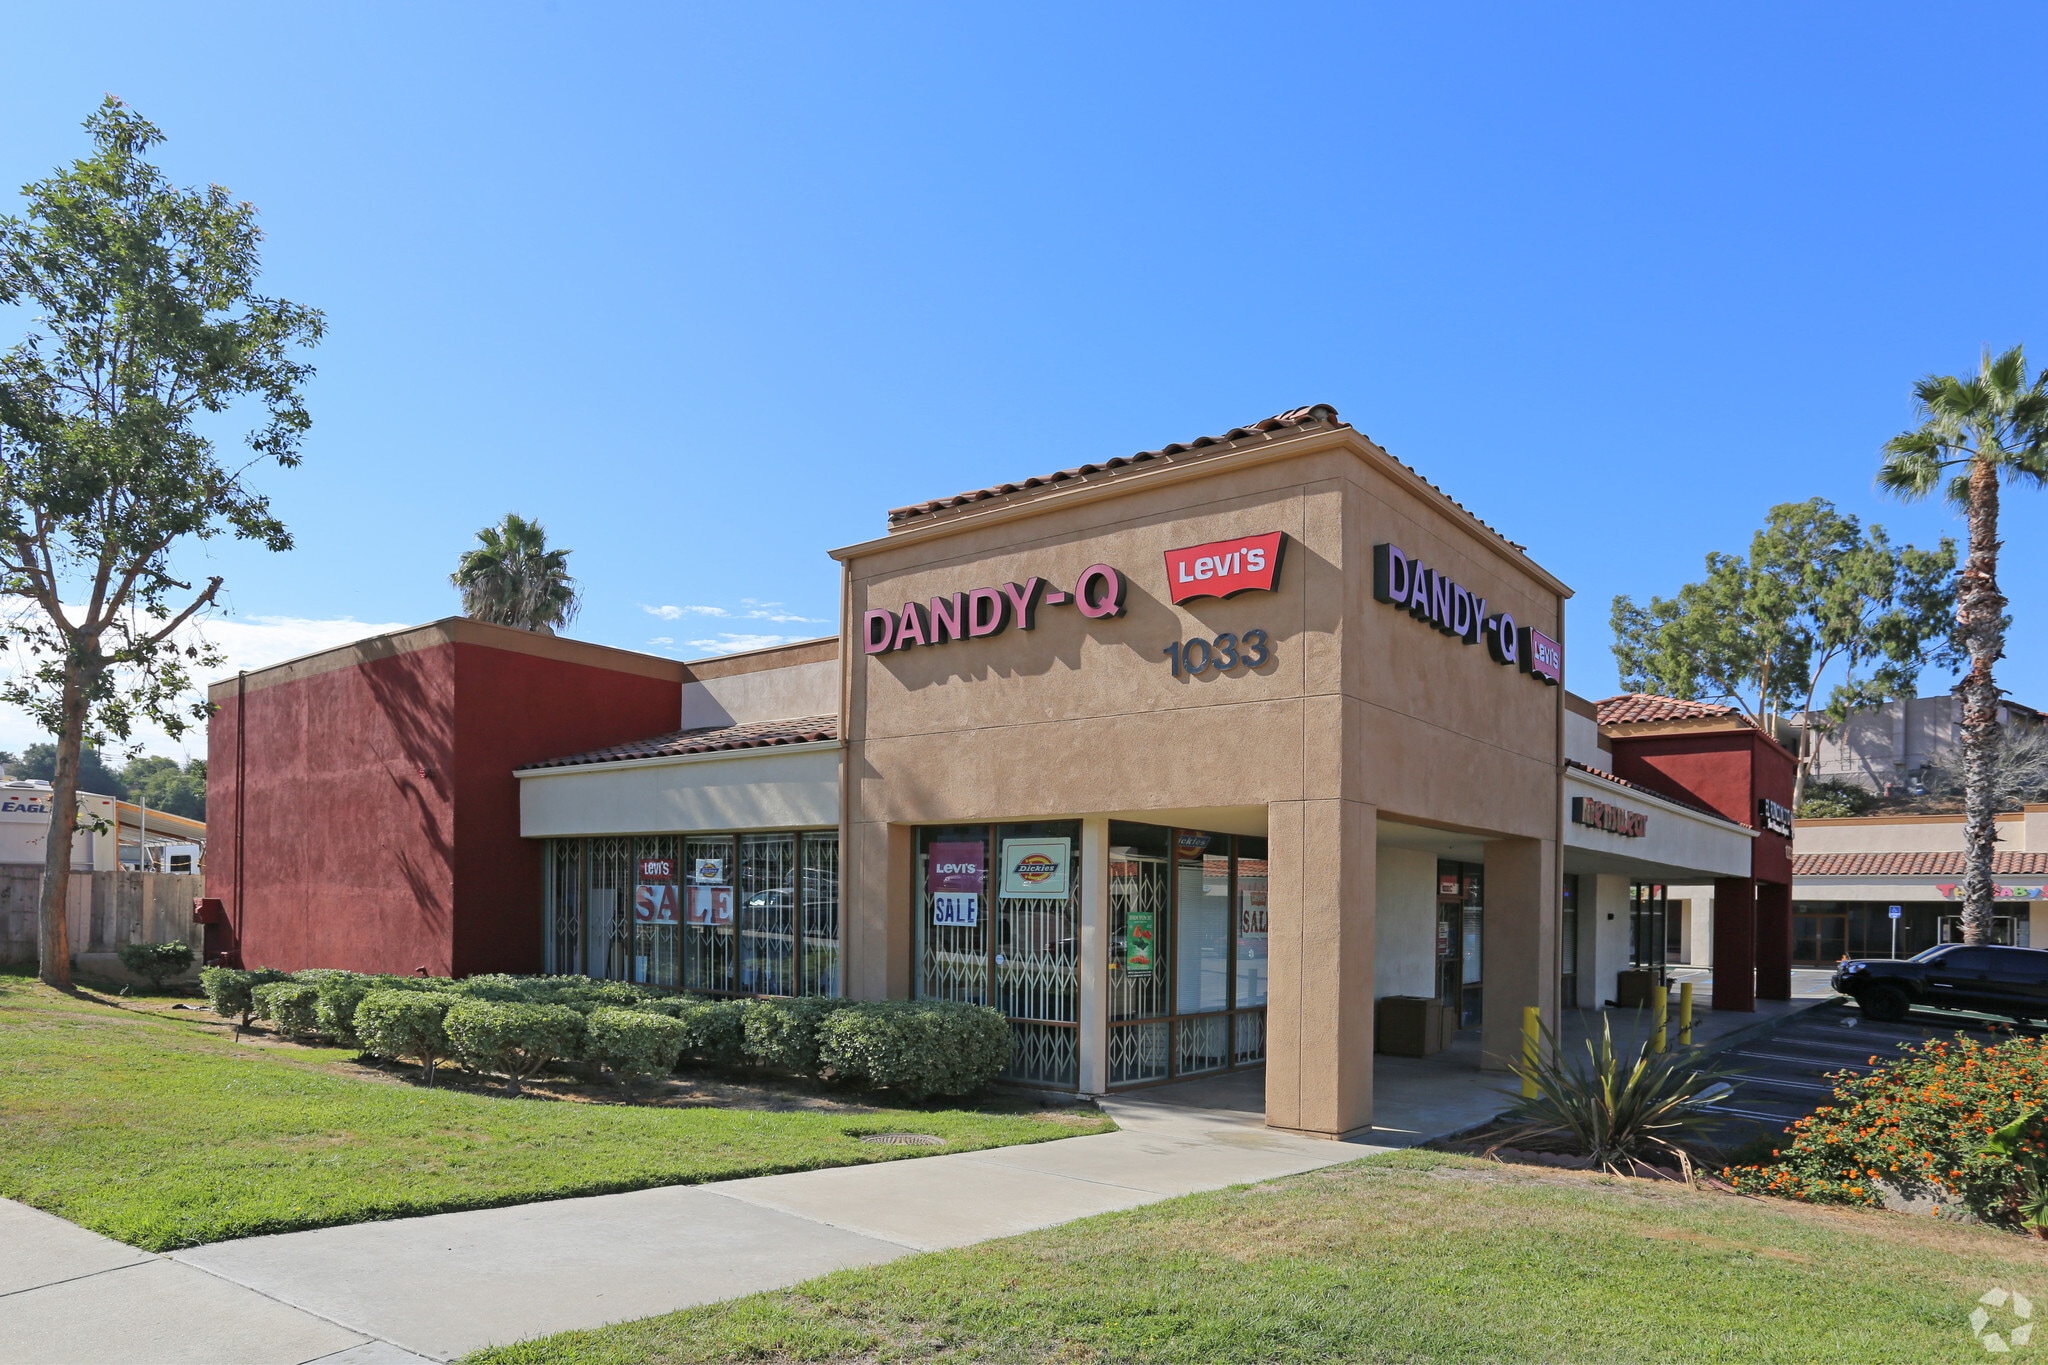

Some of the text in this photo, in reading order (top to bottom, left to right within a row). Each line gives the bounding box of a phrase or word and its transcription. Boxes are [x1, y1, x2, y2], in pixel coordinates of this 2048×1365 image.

[863, 563, 1123, 655] DANDY-Q
[1385, 543, 1518, 664] DANDY-Q
[1162, 628, 1270, 677] 1033
[1, 801, 50, 814] EAGL
[1178, 836, 1207, 847] ickies
[1017, 864, 1055, 873] Dickies
[635, 885, 731, 923] SALE
[935, 897, 975, 923] SALE
